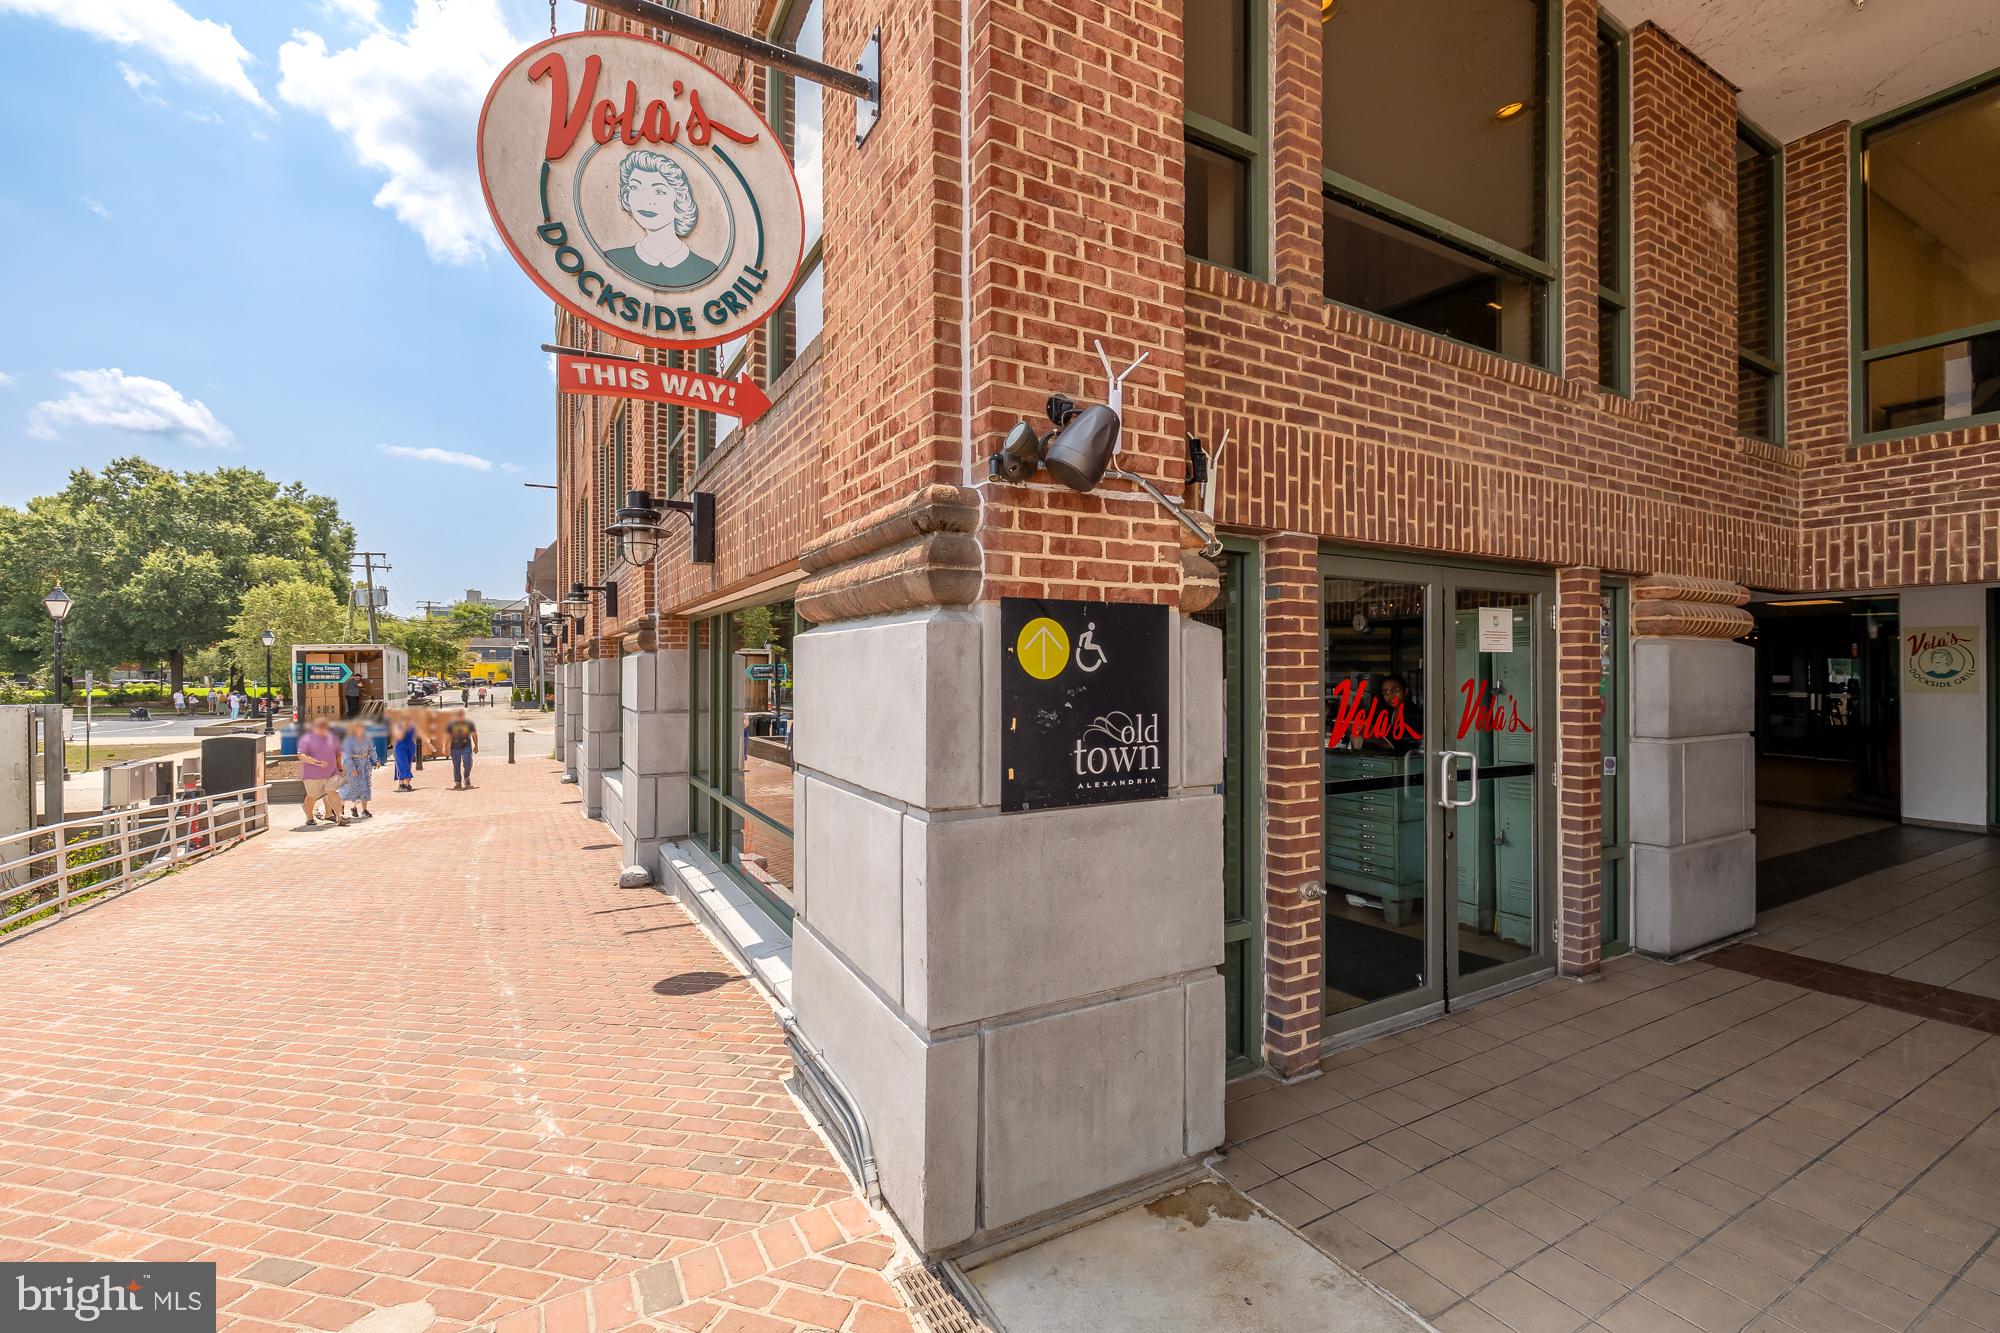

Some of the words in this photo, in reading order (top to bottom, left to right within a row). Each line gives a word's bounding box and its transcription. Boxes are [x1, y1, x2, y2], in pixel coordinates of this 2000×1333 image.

[528, 52, 759, 161] Vola's
[537, 222, 696, 332] DOCKSIDE
[703, 265, 769, 326] GRILL
[571, 363, 650, 390] THIS
[661, 375, 737, 407] WAY!
[1907, 632, 1974, 657] Vola's
[1909, 668, 1953, 688] DOCKSIDE
[1954, 669, 1977, 685] GRILL
[1121, 713, 1159, 745] old
[1327, 678, 1424, 749] Vola's
[1456, 678, 1533, 740] Vola's
[1074, 739, 1161, 775] town
[1077, 777, 1156, 789] ALEXANDRIA
